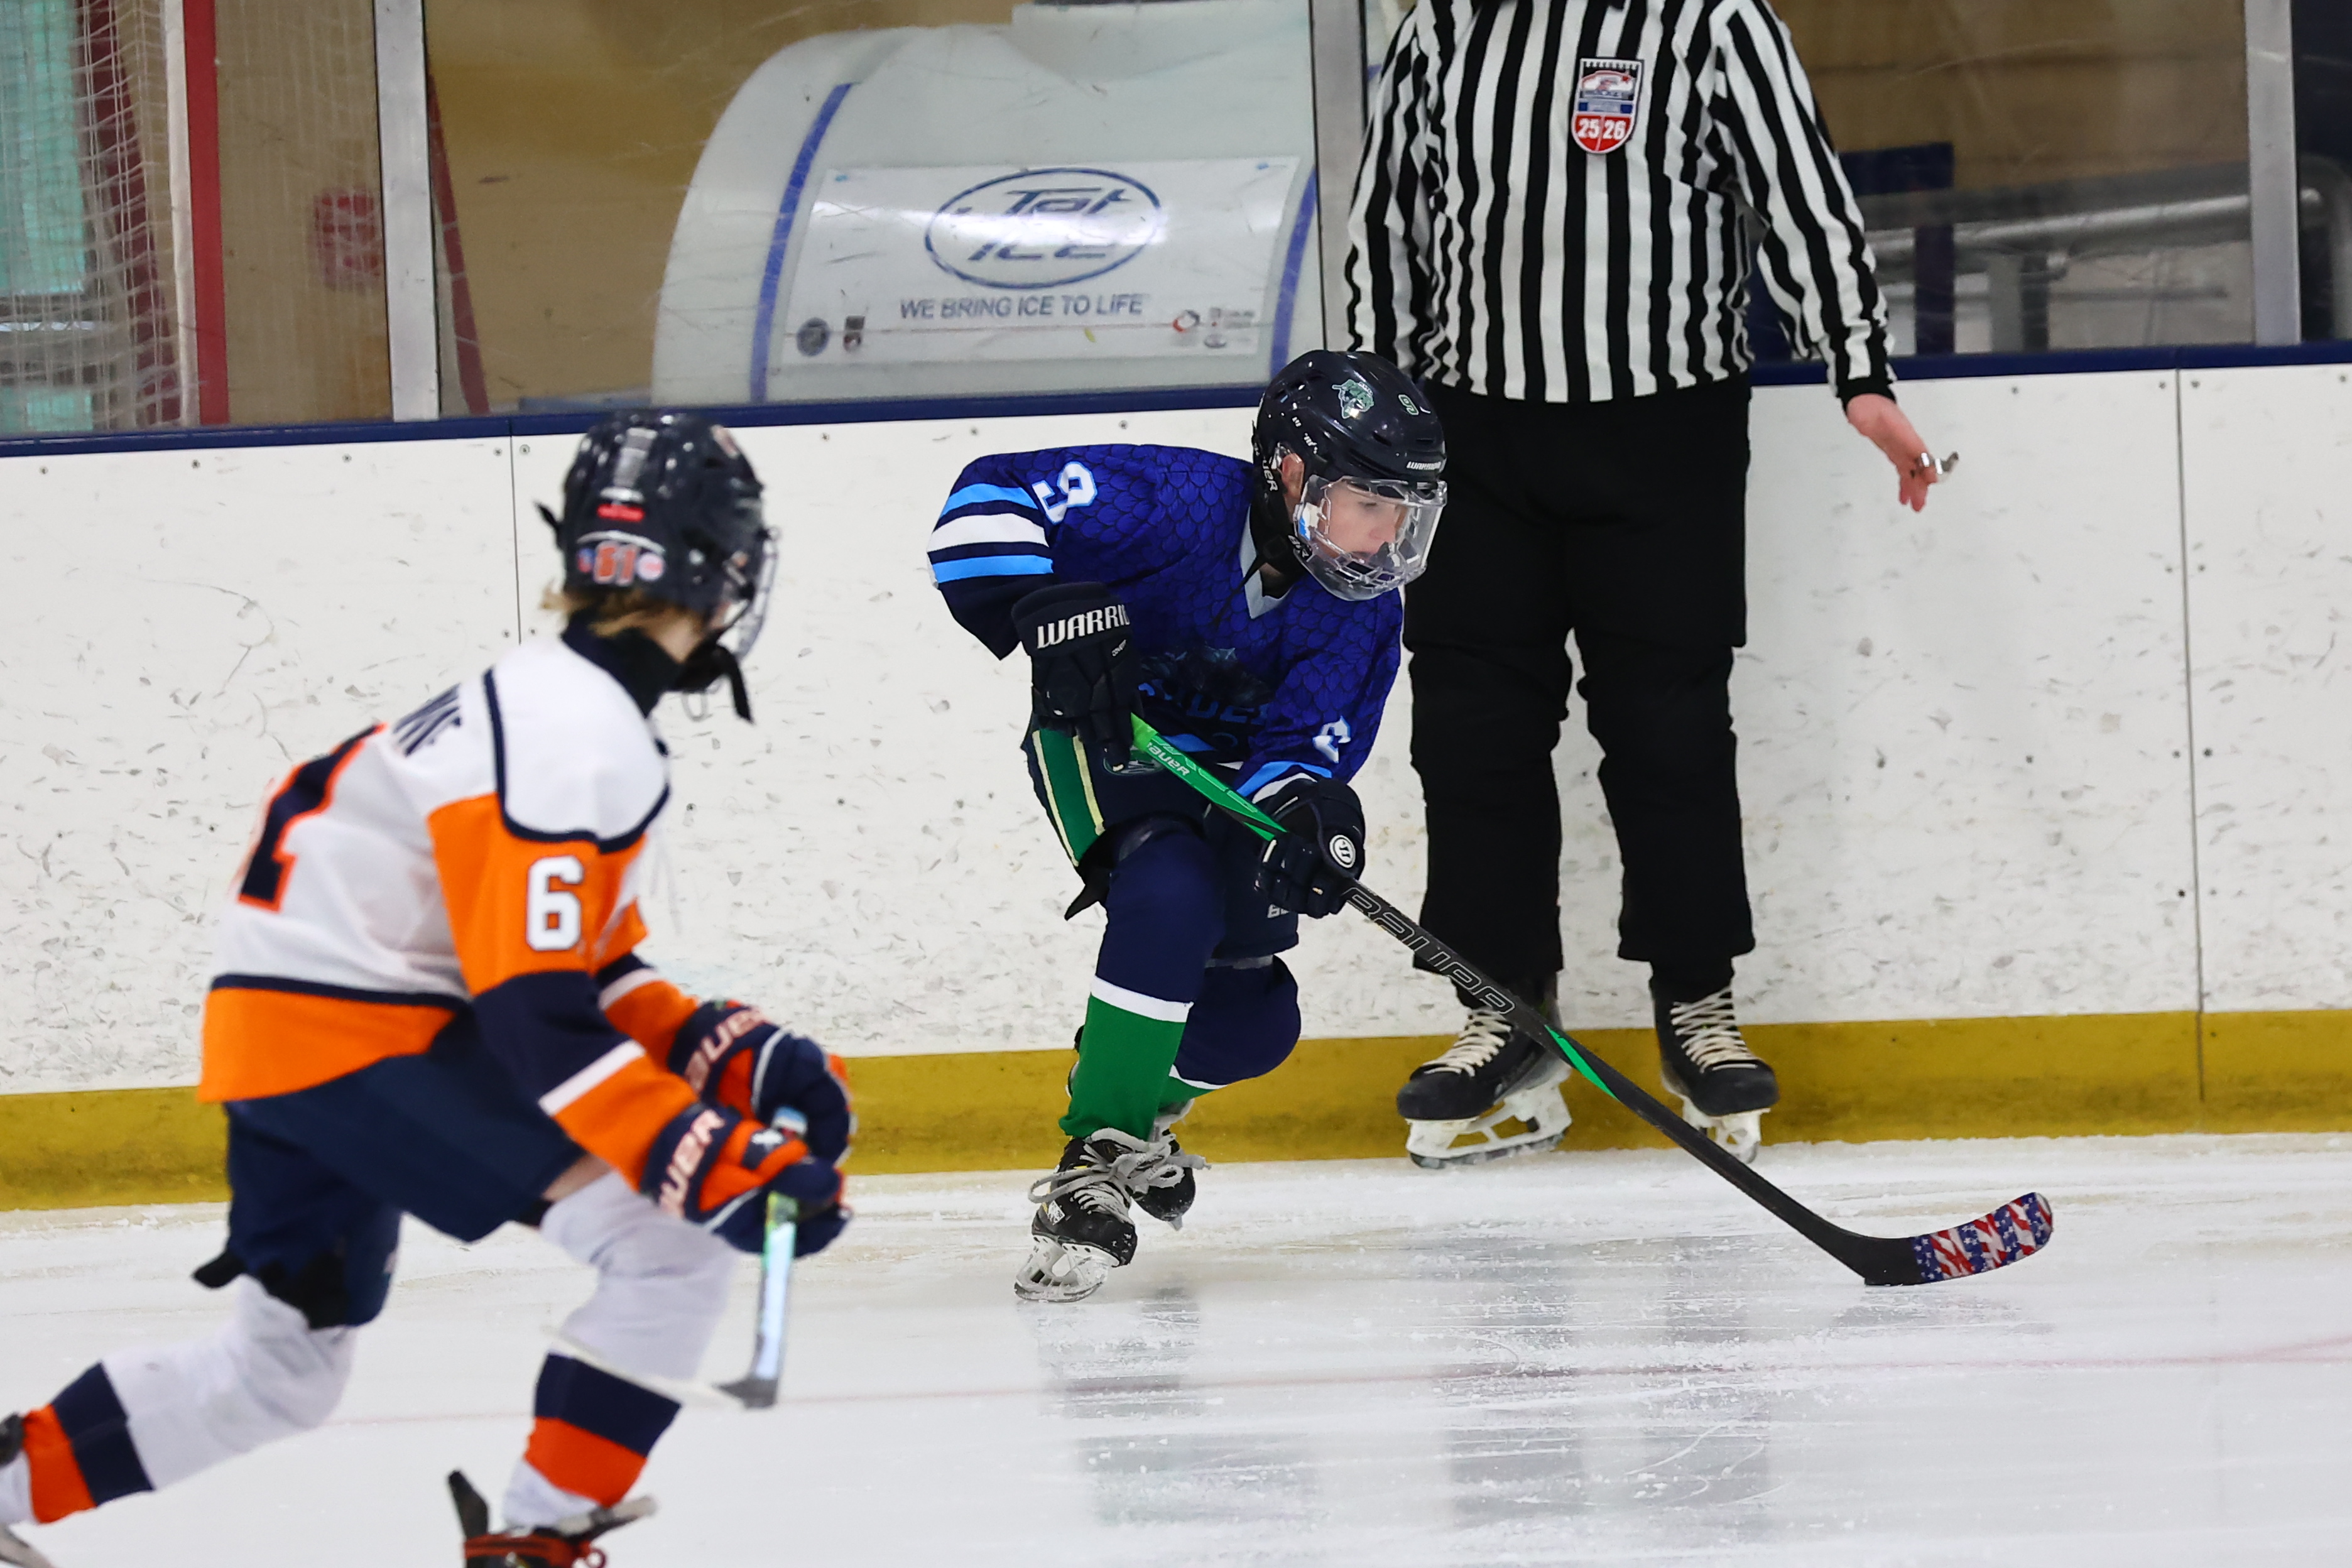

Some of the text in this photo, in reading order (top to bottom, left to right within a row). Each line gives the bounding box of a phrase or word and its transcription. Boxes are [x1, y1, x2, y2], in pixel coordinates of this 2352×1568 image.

[1577, 117, 1626, 140] 25 26
[900, 293, 1143, 318] WE BRING ICE TO LIFE
[525, 855, 584, 952] 6
